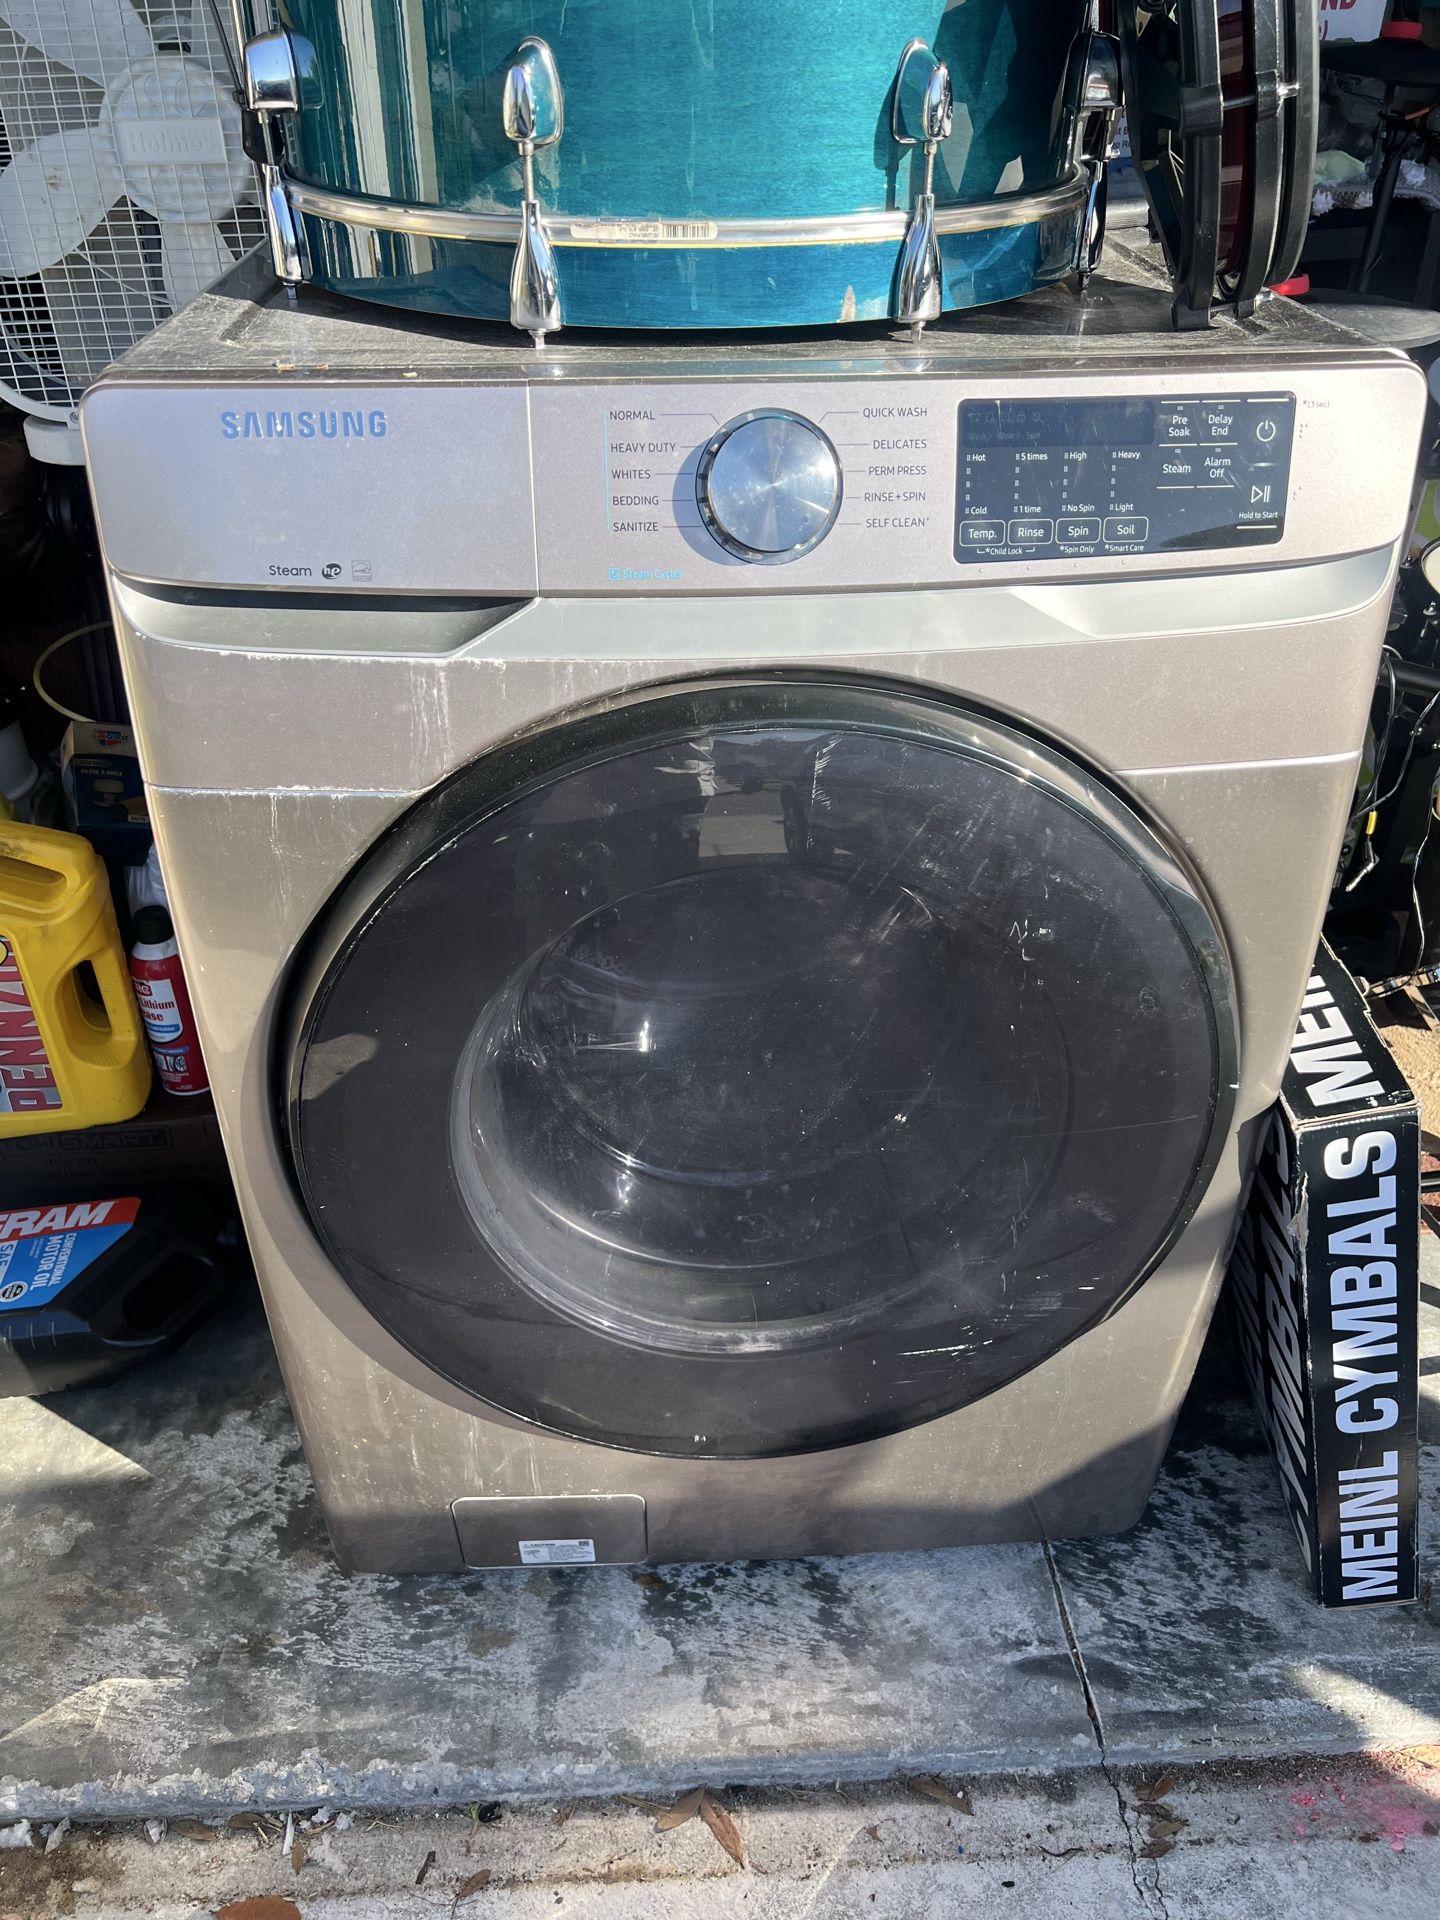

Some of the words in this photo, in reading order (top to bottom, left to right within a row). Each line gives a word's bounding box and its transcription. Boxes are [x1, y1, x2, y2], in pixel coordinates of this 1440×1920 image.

[609, 410, 656, 421] NORMAL
[863, 407, 895, 419] QUICK
[897, 406, 928, 417] WASH
[221, 410, 388, 439] SAMSUNG
[1172, 415, 1188, 425] Pre
[1208, 414, 1233, 426] Delay
[1168, 426, 1190, 437] Soak
[1211, 426, 1228, 436] End
[611, 442, 645, 453] HEAVY
[648, 442, 676, 453] DUTY
[873, 439, 928, 450] DELICATES
[972, 453, 986, 462] Hot
[1021, 453, 1026, 461] 5
[1027, 453, 1048, 461] times
[1070, 452, 1087, 461] High
[1118, 451, 1140, 460] Heavy
[1204, 457, 1231, 467] Alarm
[611, 469, 651, 480] WHITES
[868, 466, 895, 476] PERM
[897, 465, 927, 476] PRESS
[1163, 464, 1191, 474] Steam
[1209, 468, 1224, 478] Off
[612, 495, 659, 506] BEDDING
[971, 506, 987, 514] Cold
[1024, 505, 1041, 513] time
[1067, 504, 1077, 512] No
[1079, 504, 1095, 513] Spin
[1115, 503, 1134, 513] Light
[1239, 511, 1253, 519] Hold
[1262, 511, 1278, 519] Start
[613, 522, 659, 532] SANITIZE
[865, 518, 890, 528] SELF
[968, 529, 997, 540] Temp.
[1018, 527, 1044, 537] Rinse
[1068, 526, 1089, 537] Spin
[1117, 524, 1135, 535] Soil
[1008, 547, 1023, 555] Lock
[1079, 545, 1095, 554] Only
[1129, 543, 1145, 552] Care
[269, 563, 312, 577] Steam
[141, 999, 175, 1010] Lithium
[1290, 974, 1386, 1107] MEI
[37, 1234, 64, 1272] MOTOR
[47, 1231, 77, 1287] CONVENTIONAL
[29, 1273, 50, 1291] OIL
[1324, 1130, 1399, 1434] CYMBALS
[1337, 1450, 1399, 1600] MEINL
